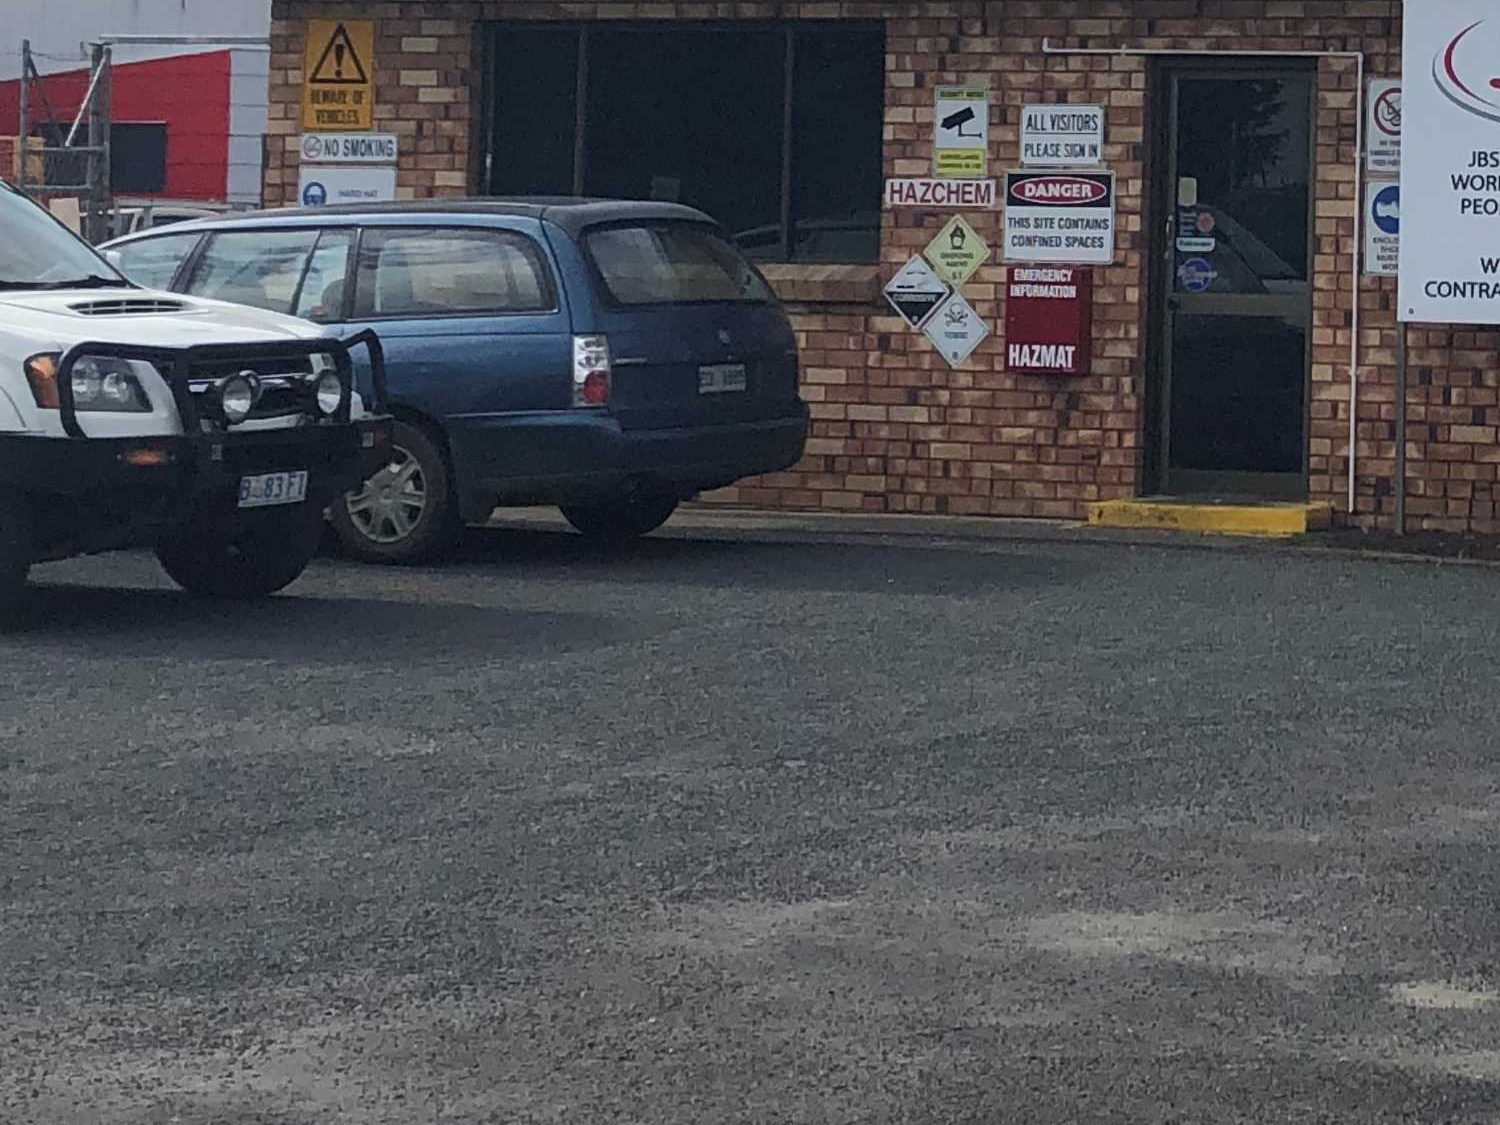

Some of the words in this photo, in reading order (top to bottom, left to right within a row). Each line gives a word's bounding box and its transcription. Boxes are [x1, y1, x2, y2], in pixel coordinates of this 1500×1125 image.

[1026, 114, 1047, 131] ALL
[1050, 114, 1098, 131] VISITORS
[324, 139, 339, 156] NO
[343, 139, 394, 157] SMOKING
[1024, 143, 1061, 157] PLEASE
[1064, 143, 1085, 157] SIGN
[1088, 144, 1098, 157] IN
[1468, 151, 1499, 167] JBS
[889, 182, 991, 203] HAZCHEM
[1024, 183, 1092, 197] DANGER
[1008, 217, 1031, 228] THIS
[1033, 217, 1055, 229] SITE
[1058, 218, 1109, 230] CONTAINS
[1011, 235, 1062, 247] CONFINED
[1065, 236, 1104, 248] SPACES
[1014, 269, 1073, 282] EMERGENCY
[1010, 285, 1077, 298] INFORMATION
[1008, 344, 1075, 368] HAZMAT
